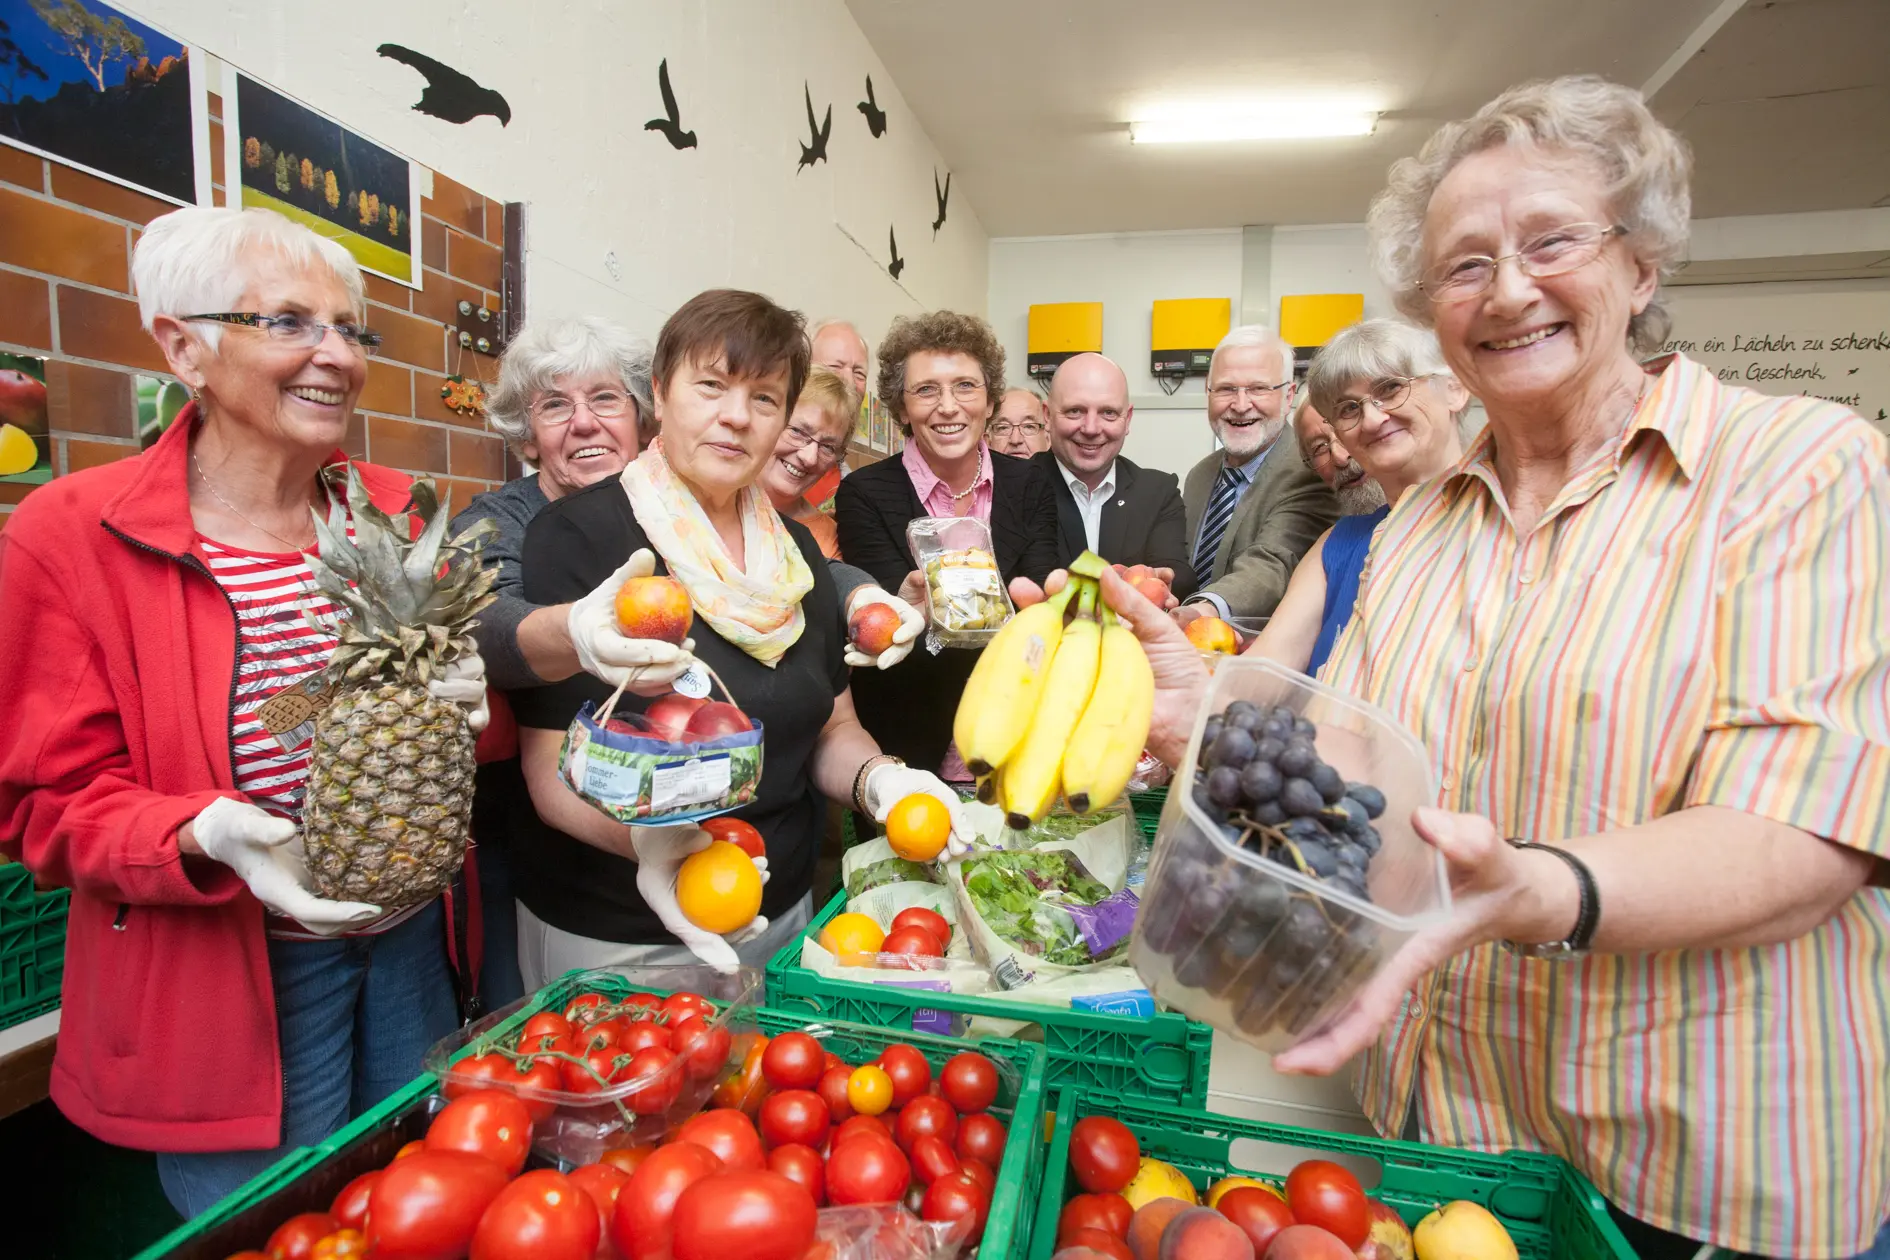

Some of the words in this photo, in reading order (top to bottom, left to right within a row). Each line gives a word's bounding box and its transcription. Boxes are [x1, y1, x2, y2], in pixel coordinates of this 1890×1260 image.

[1703, 336, 1726, 353] ein
[1732, 333, 1796, 353] Lächeln
[1802, 339, 1824, 351] zu
[1830, 330, 1890, 351] schenk
[1717, 365, 1740, 381] ein
[587, 764, 618, 779] ommer-
